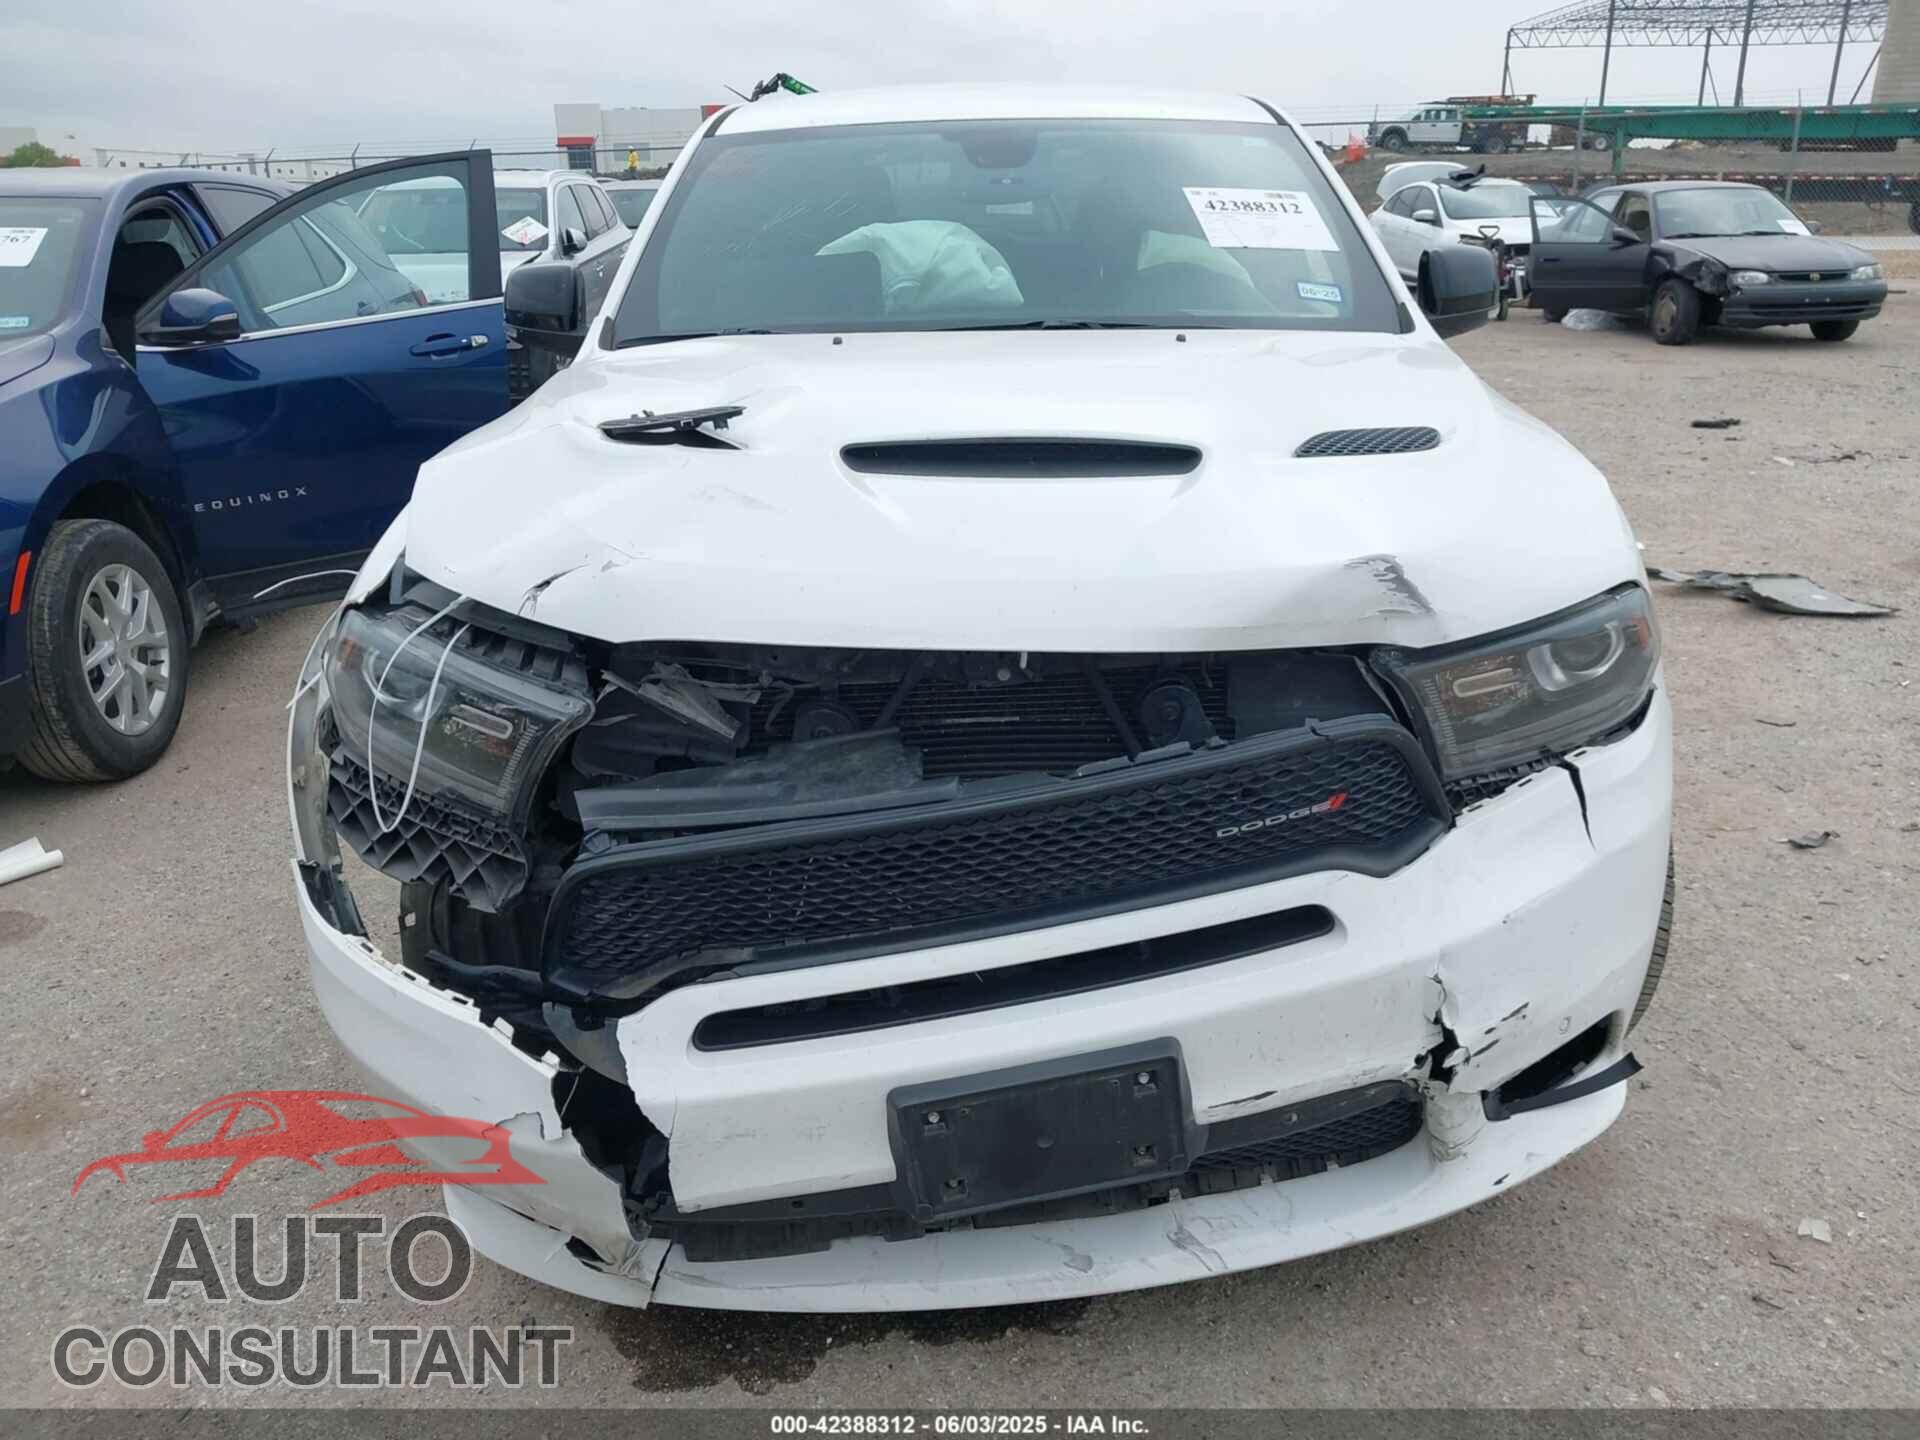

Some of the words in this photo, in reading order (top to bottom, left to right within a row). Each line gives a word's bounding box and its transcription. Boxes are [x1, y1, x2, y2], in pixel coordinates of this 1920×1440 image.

[1204, 200, 1303, 214] 42388312
[193, 487, 308, 512] EQUINOX
[1216, 801, 1331, 837] DODGE
